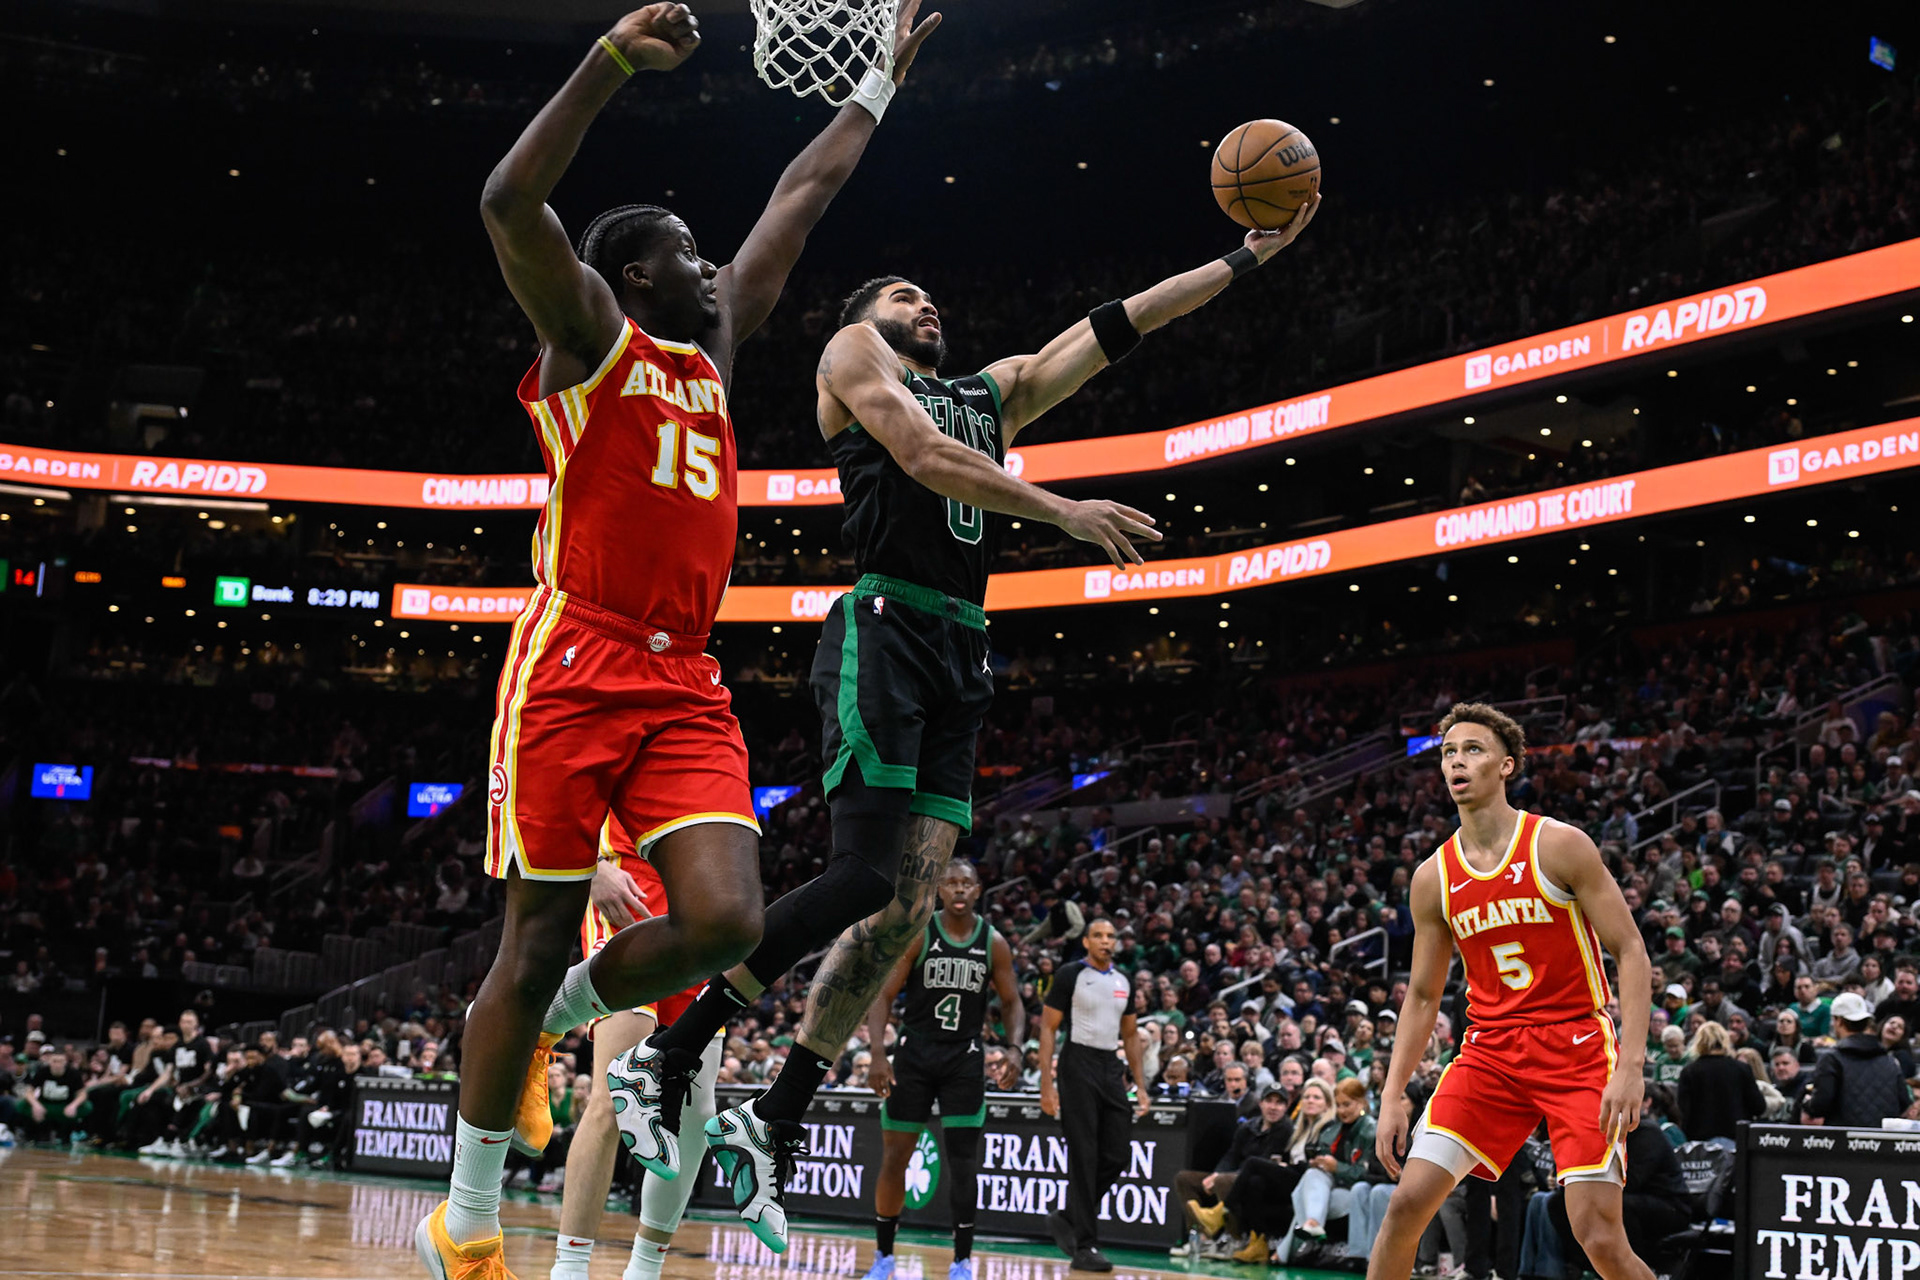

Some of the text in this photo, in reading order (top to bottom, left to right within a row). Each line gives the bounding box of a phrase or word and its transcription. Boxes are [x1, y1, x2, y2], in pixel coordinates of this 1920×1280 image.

[1492, 336, 1590, 376] GARDEN
[620, 360, 727, 428] ATLANT
[959, 386, 989, 397] Amica
[1165, 415, 1249, 463] COMMAND
[1274, 394, 1332, 436] COURT
[651, 418, 721, 502] 15
[1802, 431, 1919, 473] GARDEN
[0, 453, 267, 494] GARDEN RAPID7
[422, 477, 550, 505] COMMAND TH
[796, 478, 842, 496] GAR
[1435, 499, 1536, 547] COMMAND
[1566, 479, 1636, 523] COURT
[218, 581, 294, 603] TD Bank
[1112, 568, 1206, 592] GARDEN
[307, 588, 380, 609] 8:29 PM
[430, 594, 526, 613] GARDEN
[1451, 897, 1554, 940] ATLANTA
[923, 957, 987, 993] CELTICS
[1489, 941, 1535, 991] 5
[934, 993, 961, 1032] 4
[361, 1100, 449, 1132] FRANKLIN
[354, 1128, 453, 1163] TEMPLETON
[1758, 1133, 1791, 1148] xfinity
[1802, 1135, 1835, 1150] xfinity
